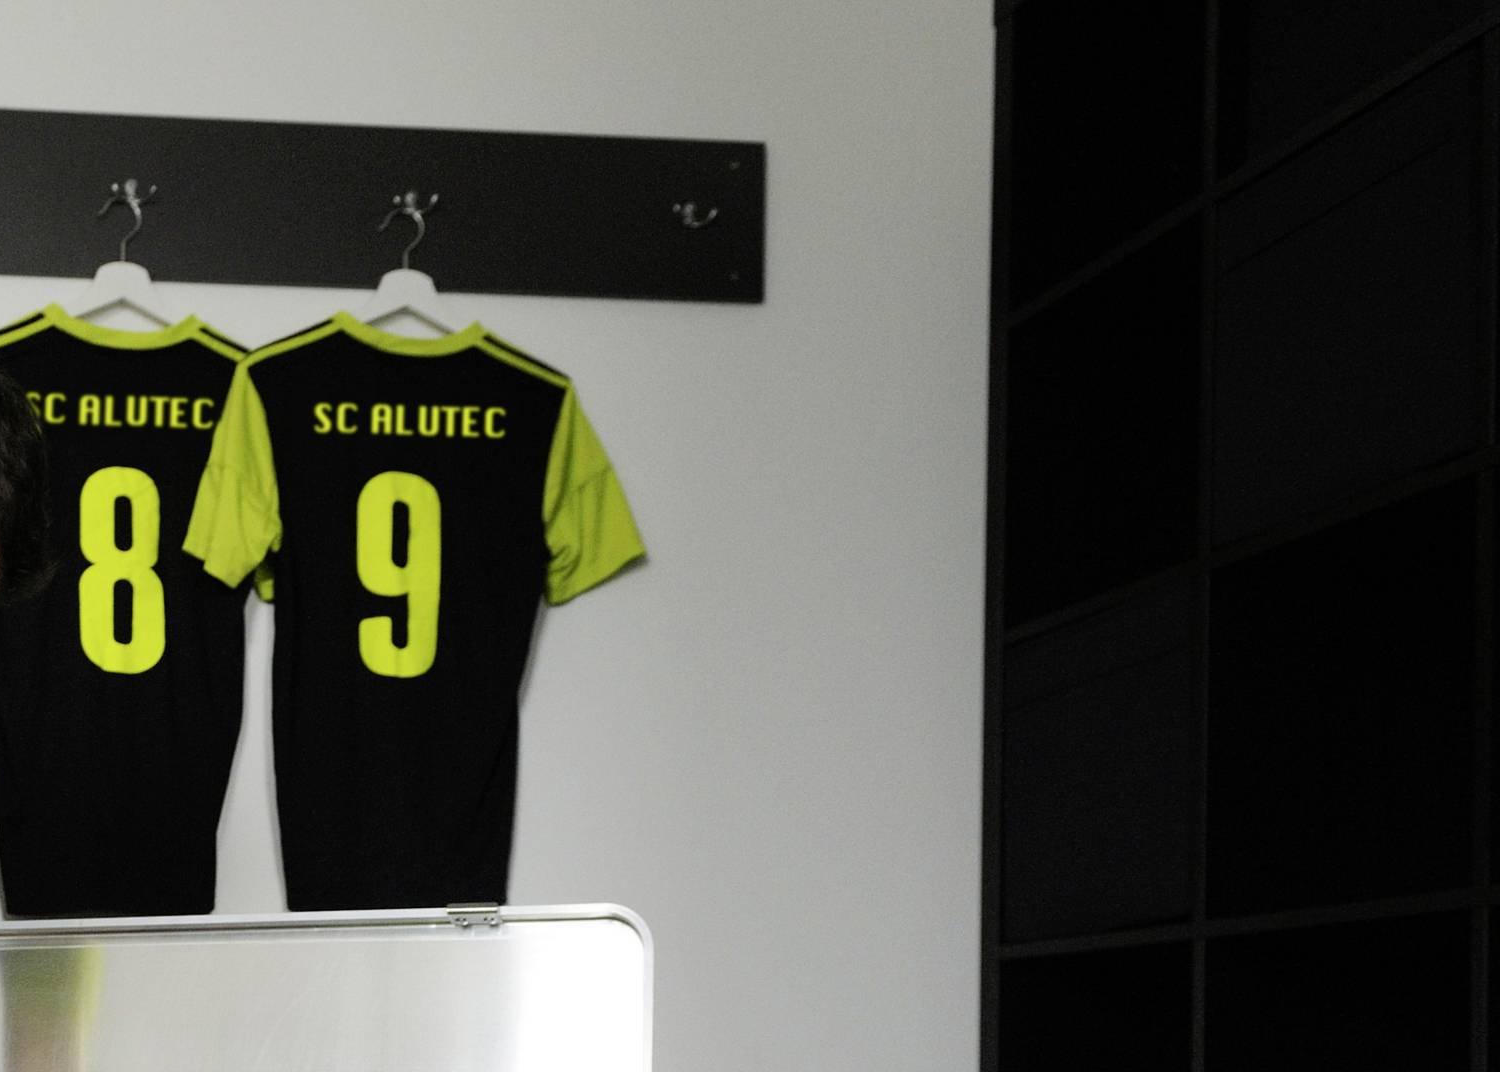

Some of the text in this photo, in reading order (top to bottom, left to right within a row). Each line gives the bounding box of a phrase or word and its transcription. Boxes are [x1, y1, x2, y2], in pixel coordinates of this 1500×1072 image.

[78, 394, 214, 430] ALUTEC
[313, 402, 507, 438] SC ALUTEC
[79, 466, 166, 674] 8
[356, 471, 442, 678] 9
